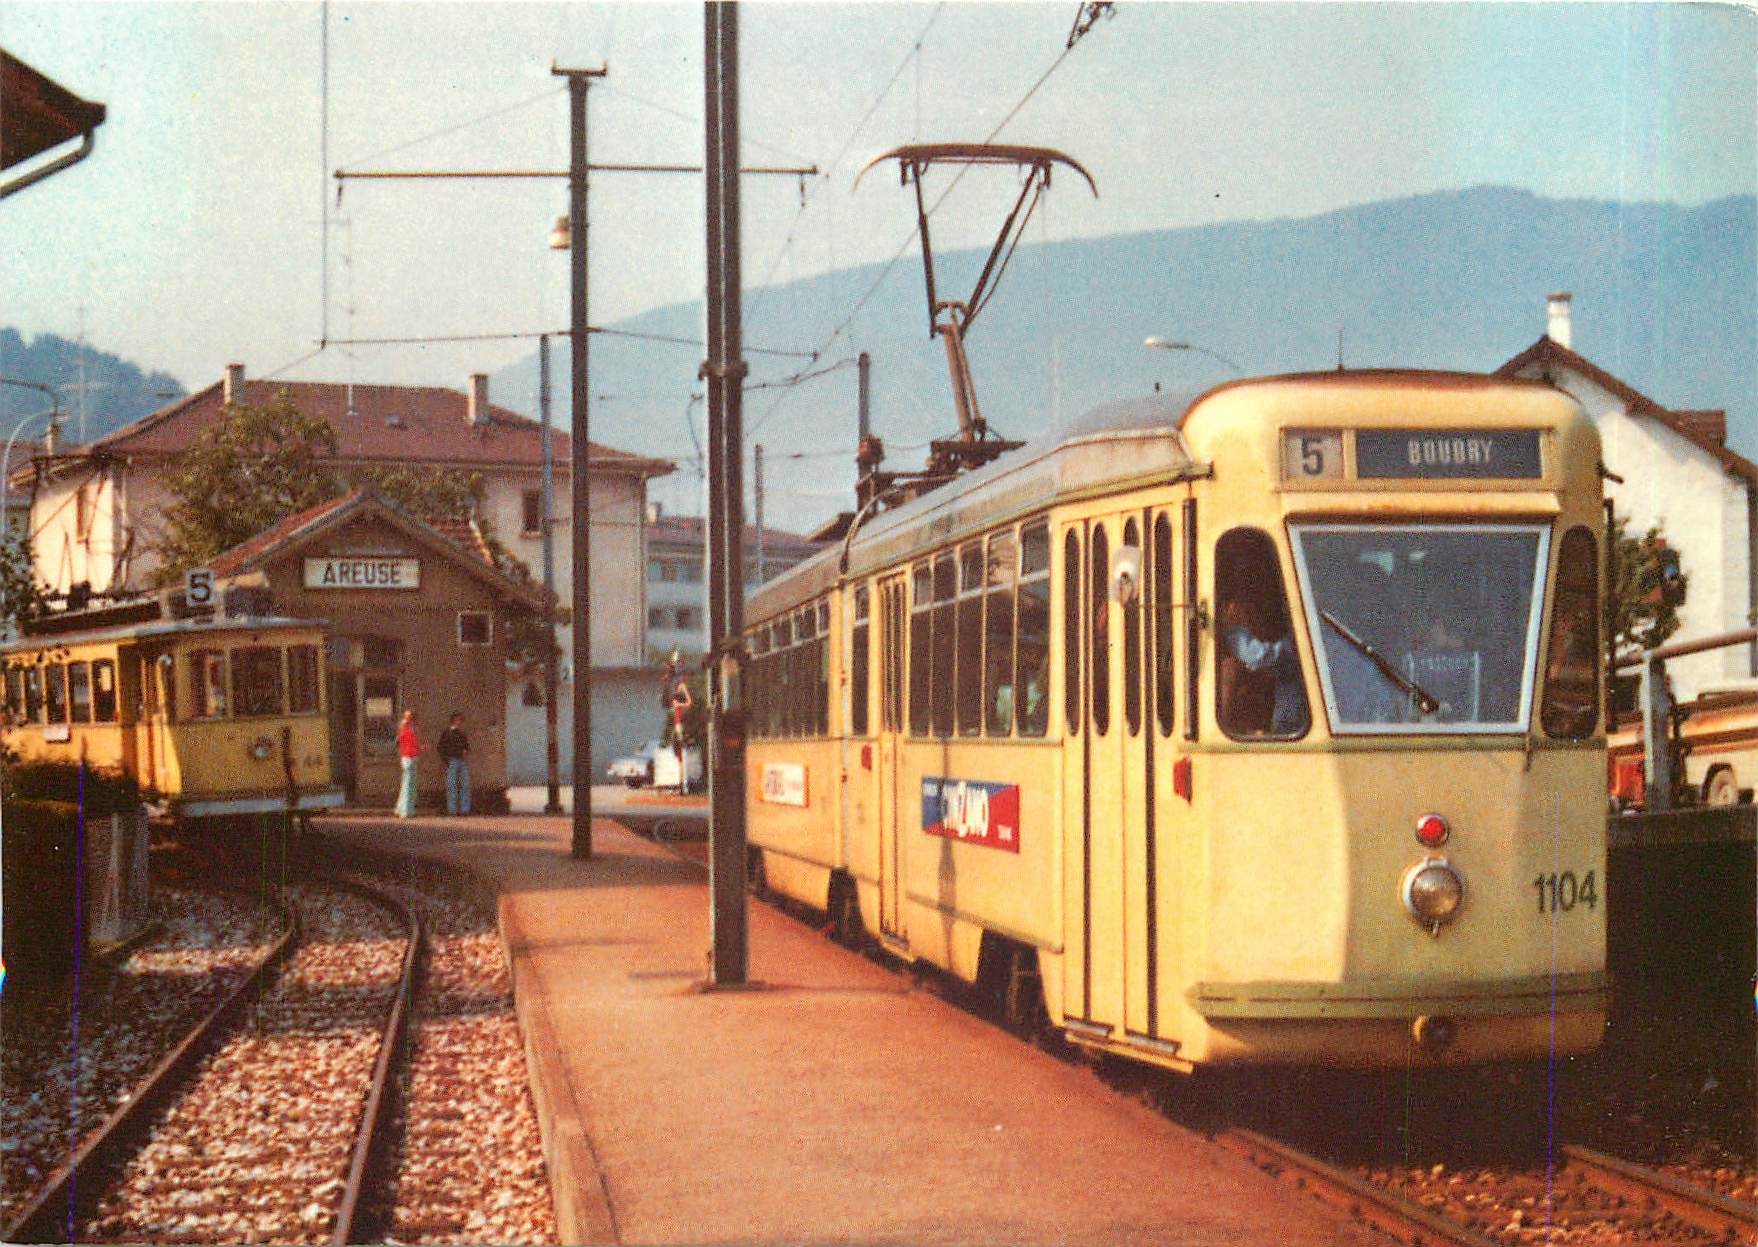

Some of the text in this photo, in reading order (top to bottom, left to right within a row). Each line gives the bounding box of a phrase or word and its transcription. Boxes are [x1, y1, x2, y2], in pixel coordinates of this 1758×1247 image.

[1301, 438, 1323, 477] 5
[1407, 437, 1492, 465] BOUDRY
[189, 572, 211, 603] 5
[322, 561, 402, 586] AREUSE
[1533, 869, 1598, 913] 1104
